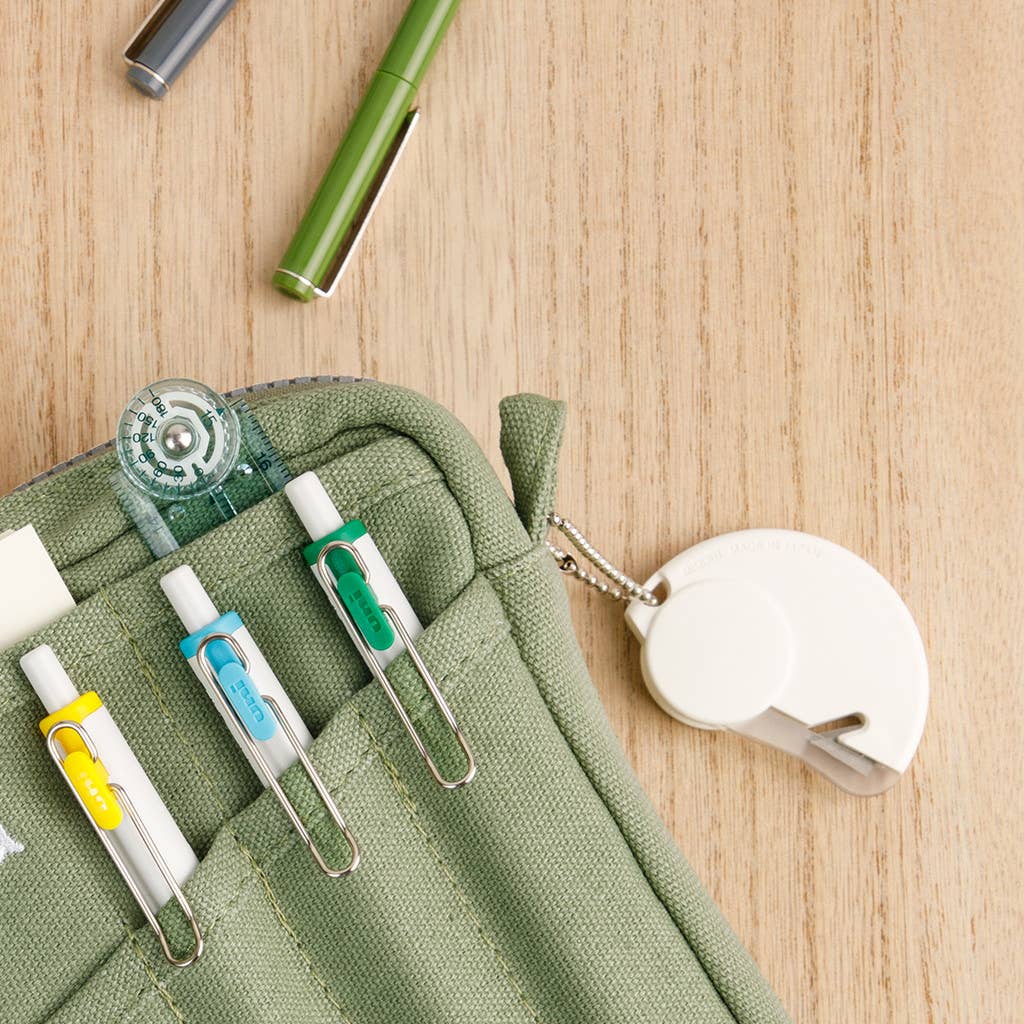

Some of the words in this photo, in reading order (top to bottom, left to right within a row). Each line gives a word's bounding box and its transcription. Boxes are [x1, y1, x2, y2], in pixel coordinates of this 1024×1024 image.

[151, 396, 169, 418] 180
[137, 412, 158, 428] 150
[132, 432, 155, 443] 120
[138, 449, 155, 464] 90
[257, 452, 272, 471] 16
[173, 465, 184, 483] 30
[348, 589, 382, 633] uni
[230, 679, 265, 723] uni
